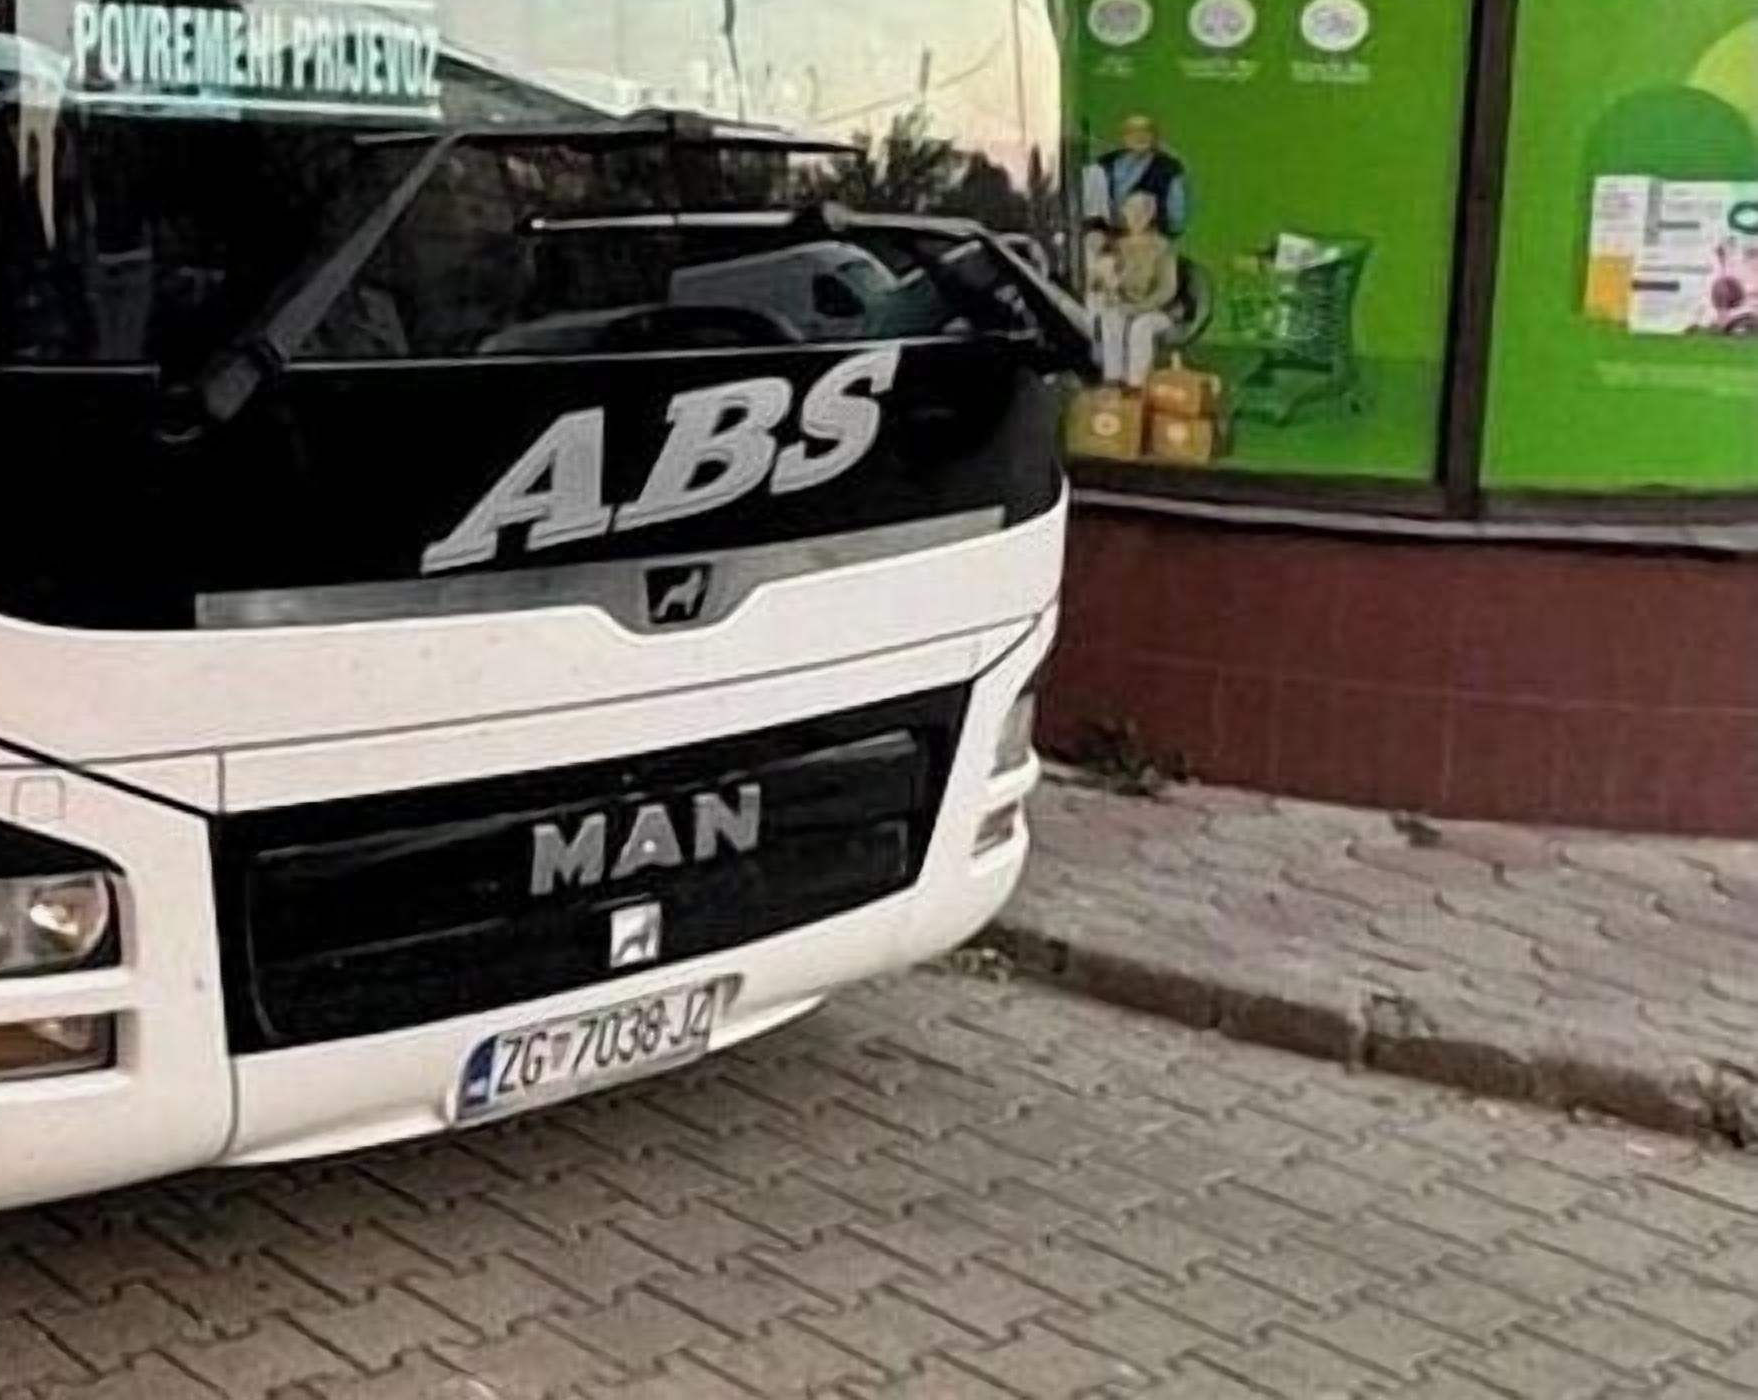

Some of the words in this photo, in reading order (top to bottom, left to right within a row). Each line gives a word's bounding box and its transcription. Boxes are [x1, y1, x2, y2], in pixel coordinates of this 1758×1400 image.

[419, 343, 903, 575] ABS
[530, 782, 763, 896] MAN
[497, 1031, 548, 1094] ZG
